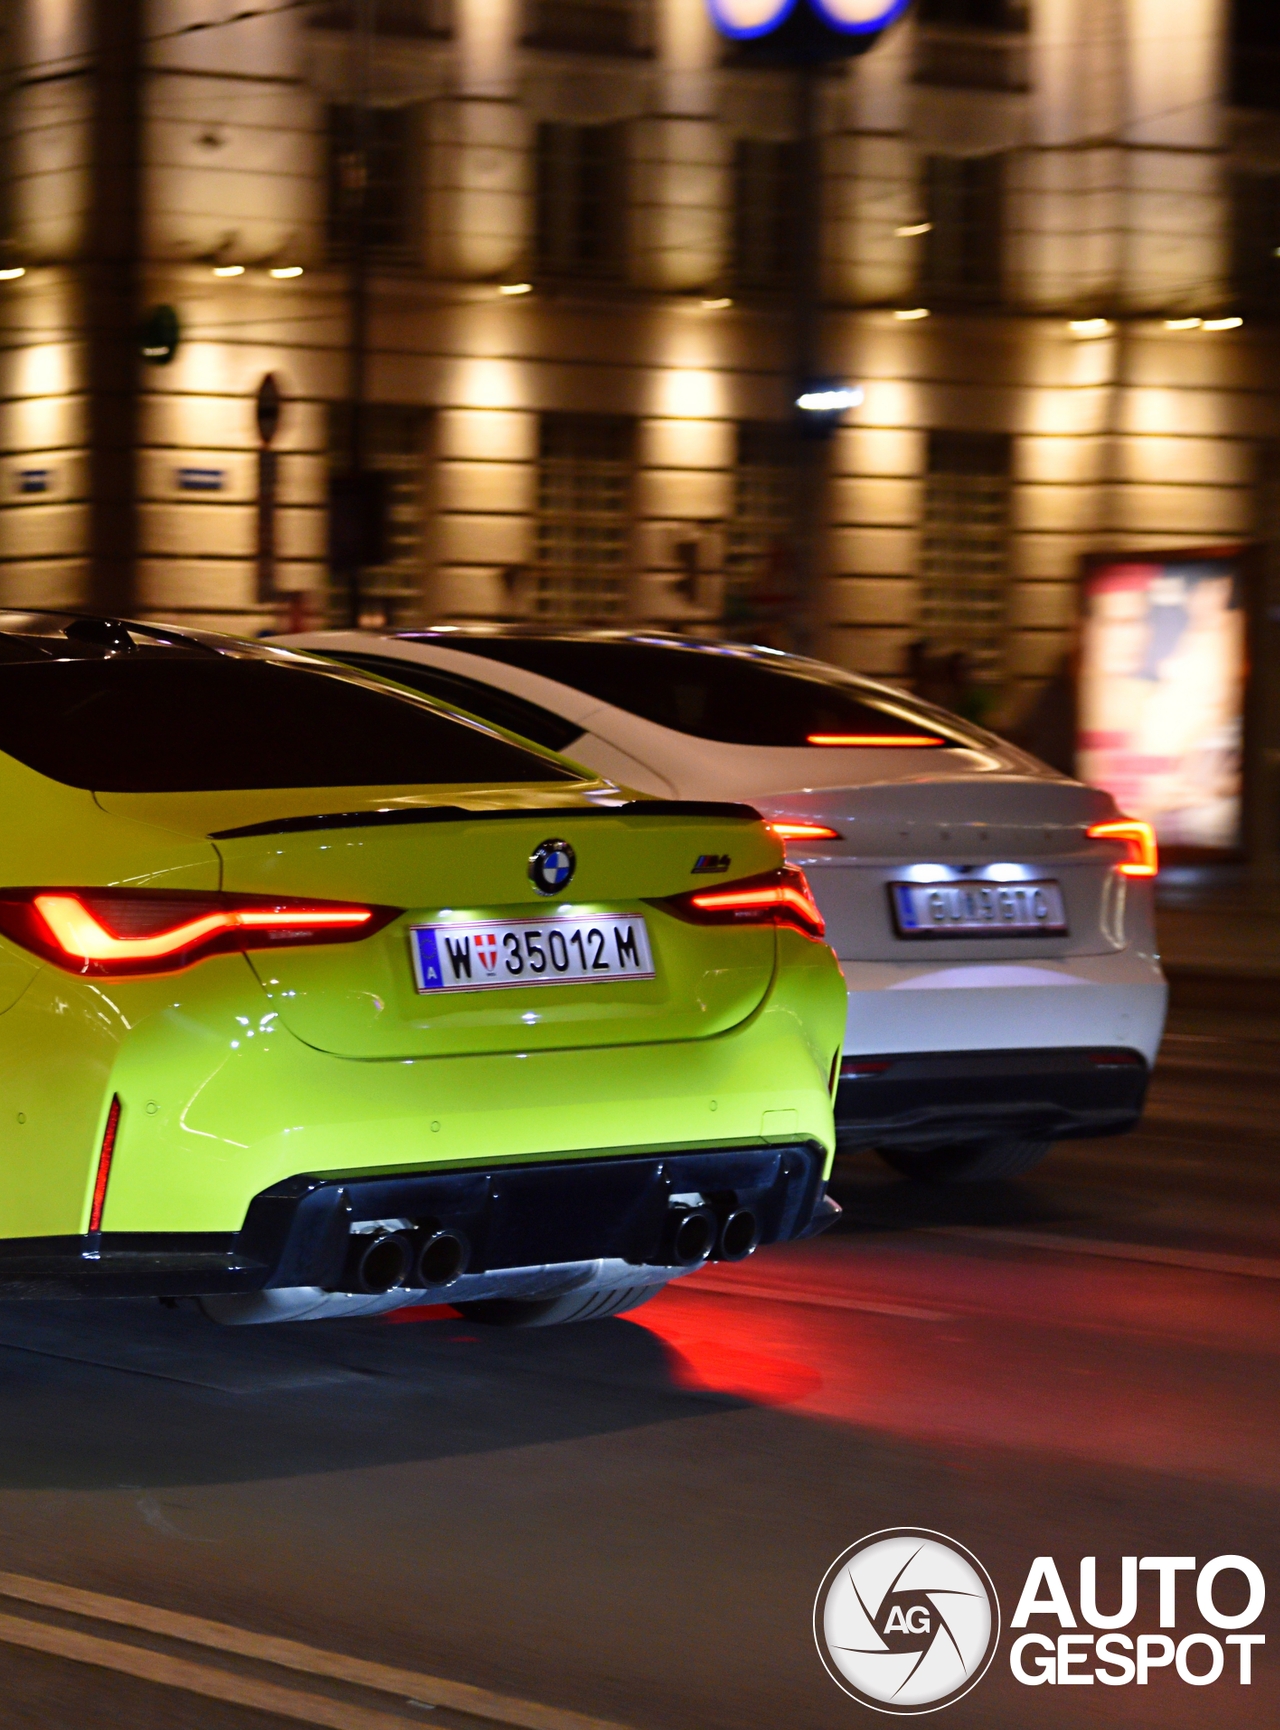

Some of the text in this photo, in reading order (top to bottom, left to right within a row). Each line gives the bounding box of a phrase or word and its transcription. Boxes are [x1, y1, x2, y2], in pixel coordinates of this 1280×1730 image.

[445, 926, 640, 979] W 35012 M
